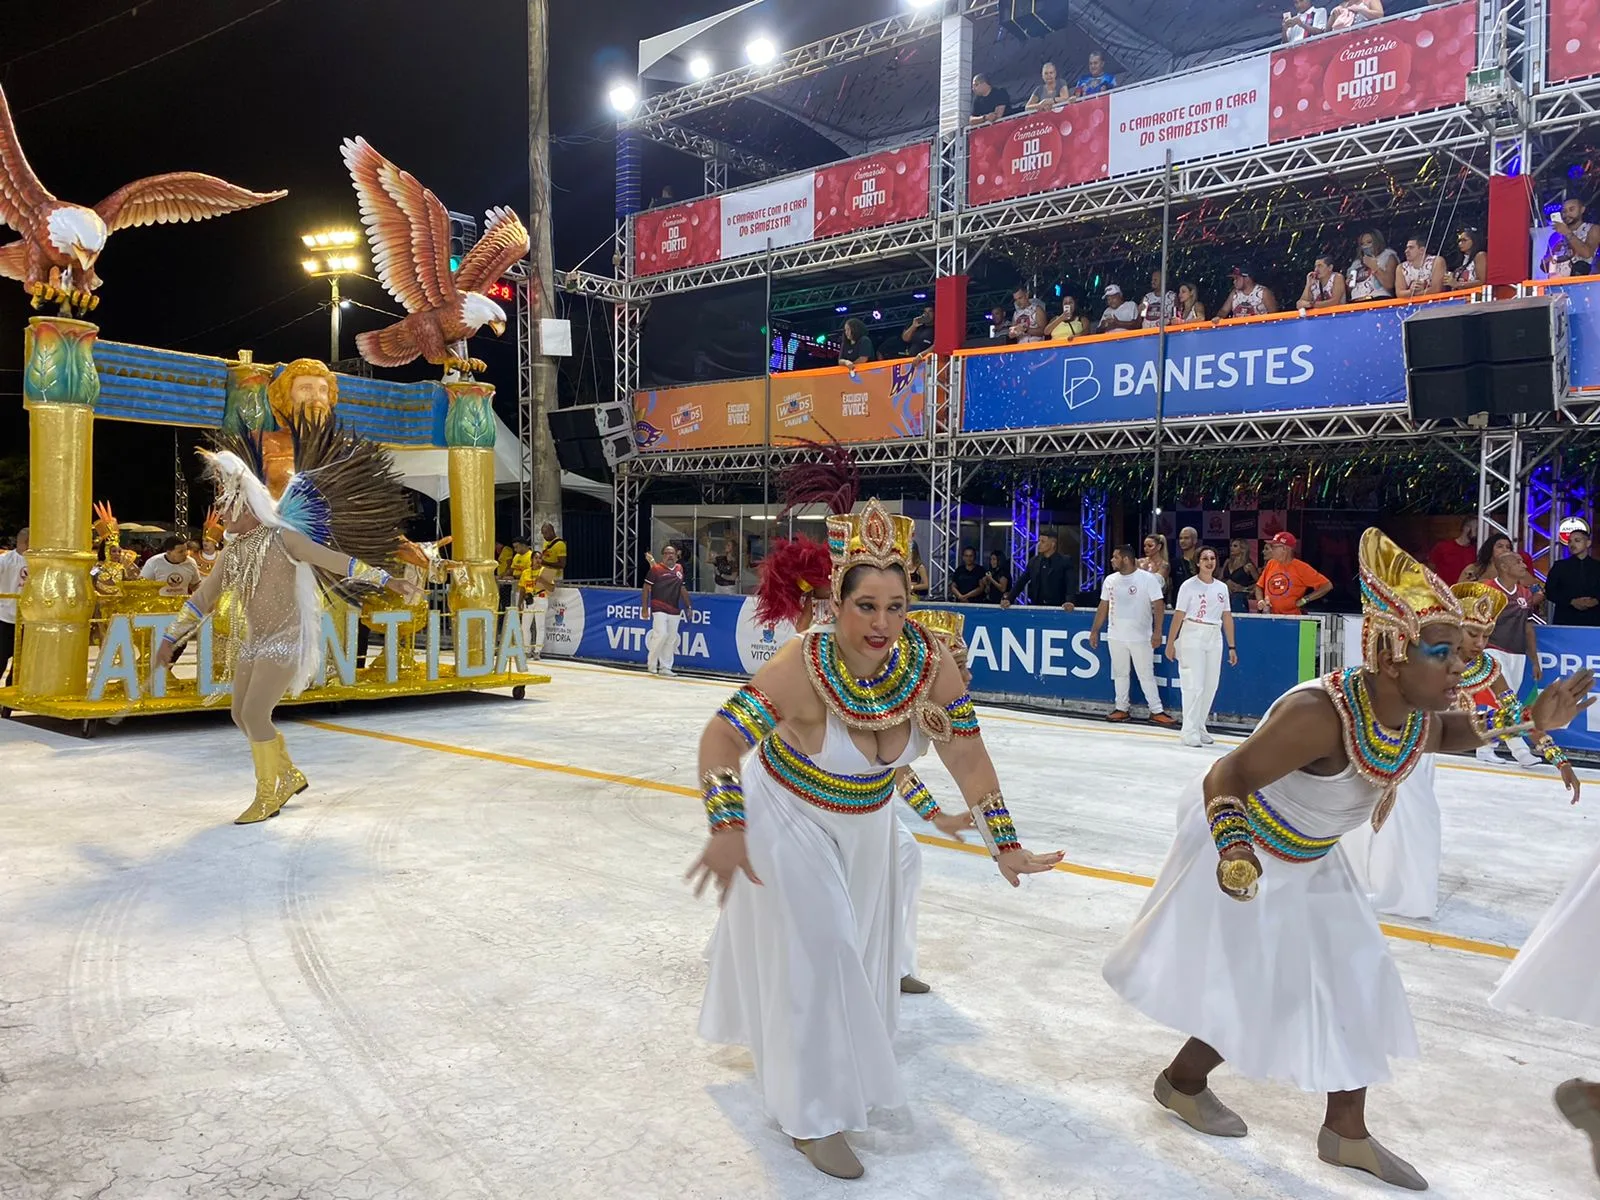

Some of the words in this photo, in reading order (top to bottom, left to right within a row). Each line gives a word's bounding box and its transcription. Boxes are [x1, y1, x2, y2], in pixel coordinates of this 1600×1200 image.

[1340, 38, 1398, 63] Camarote
[1354, 56, 1378, 78] DO
[1337, 70, 1397, 102] PORTO
[1119, 121, 1127, 133] O
[1129, 106, 1185, 131] CAMAROTE
[1188, 101, 1212, 119] COM
[1215, 97, 1224, 111] A
[1226, 89, 1257, 108] CARA
[1350, 94, 1379, 111] 2022
[1012, 125, 1053, 142] Camarote
[1139, 131, 1155, 147] DO
[1158, 113, 1229, 142] SAMBISTA!
[1023, 137, 1040, 157] DO
[1011, 151, 1053, 174] PORTO
[861, 177, 876, 194] DO
[1020, 170, 1040, 183] 2022
[733, 208, 766, 225] CAMAROTE
[767, 204, 782, 217] COM
[789, 197, 808, 211] CARA
[852, 189, 886, 211] PORTO
[668, 226, 679, 240] DO
[750, 215, 792, 235] SAMBISTA!
[661, 237, 687, 255] PORTO
[1113, 344, 1314, 397] BANESTES
[606, 604, 688, 624] PREFIA
[691, 609, 711, 625] DE
[605, 625, 711, 658] VITIA
[87, 606, 529, 702] ATLNTIDA
[967, 624, 1182, 690] ANES
